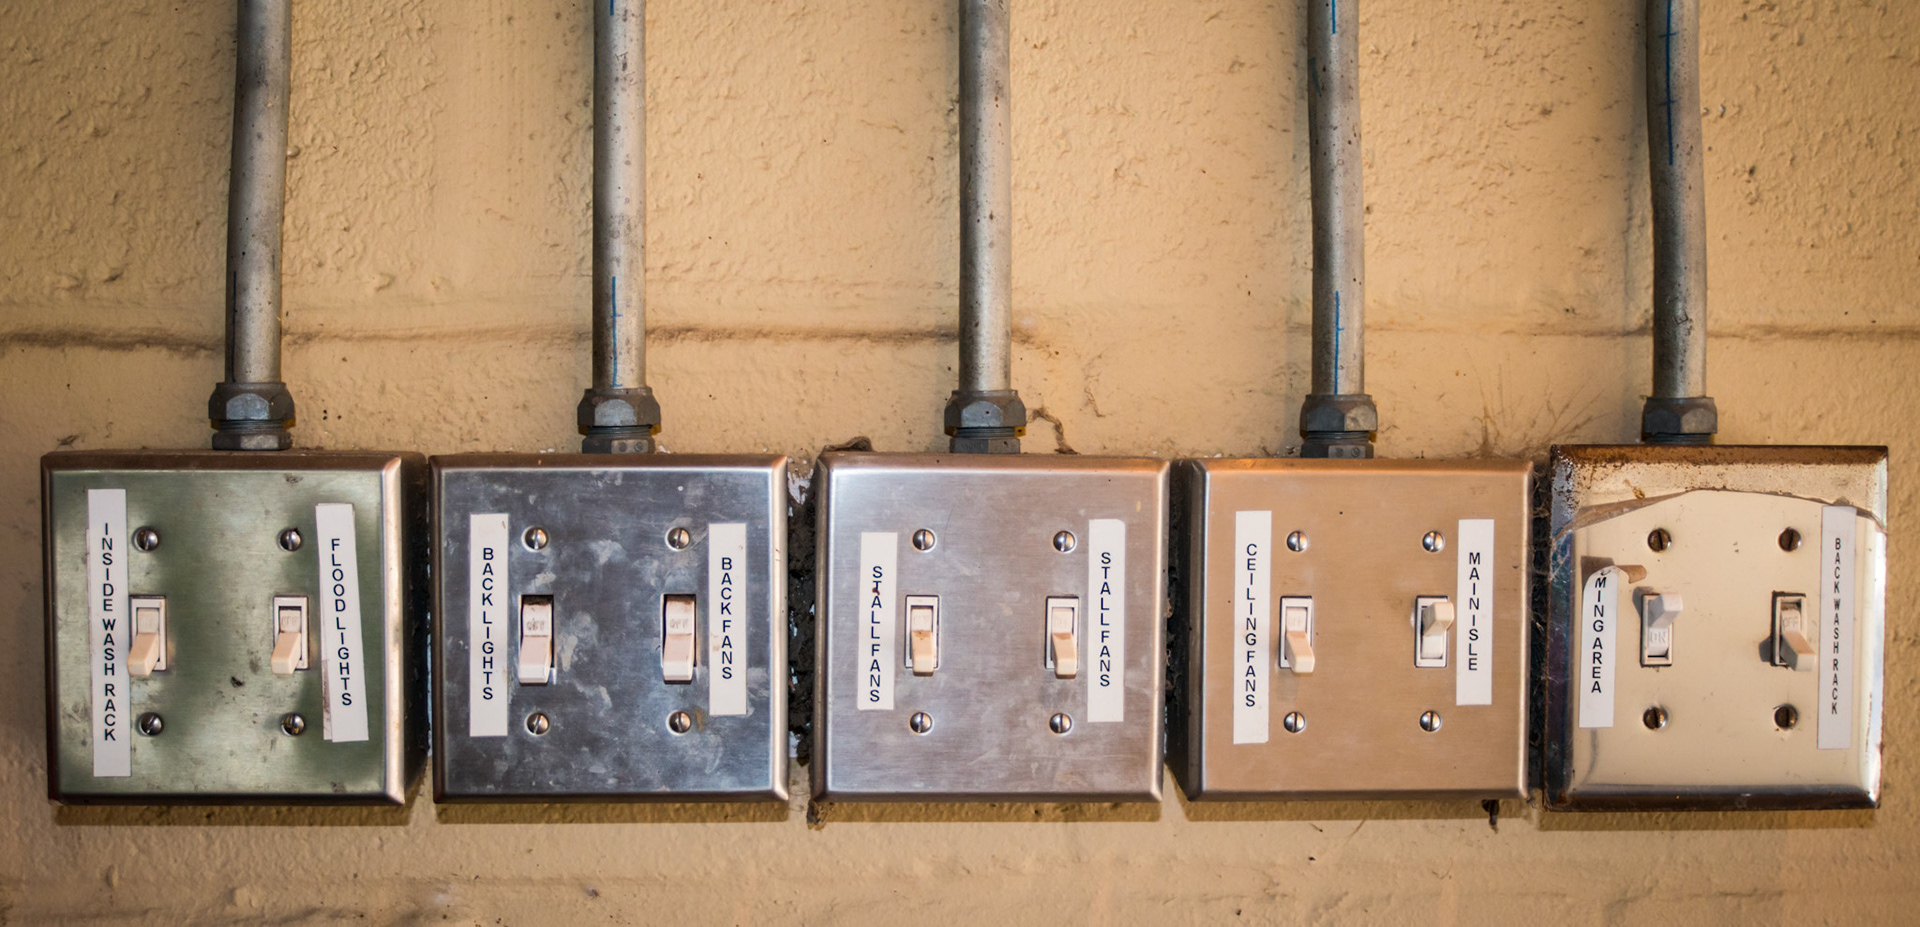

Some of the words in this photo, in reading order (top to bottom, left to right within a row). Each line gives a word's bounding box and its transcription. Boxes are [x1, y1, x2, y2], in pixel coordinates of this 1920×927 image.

[101, 522, 115, 612] INSIDE
[331, 538, 346, 613] FLOOD
[481, 547, 495, 607] BACK
[720, 556, 733, 616] BACK
[1099, 551, 1112, 626] STALL
[1244, 543, 1258, 647] CEILING
[1468, 551, 1481, 611] MAIN
[1833, 537, 1842, 594] BACK
[870, 565, 883, 640] STALL
[1833, 598, 1841, 654] WASH
[101, 618, 117, 677] WASH
[335, 616, 353, 706] LIGHTS
[481, 610, 495, 701] LIGHTS
[720, 619, 733, 680] FANS
[1099, 630, 1111, 687] FANS
[1468, 614, 1479, 671] ISLE
[1590, 636, 1603, 694] AREA
[869, 643, 882, 703] FANS
[1244, 650, 1257, 708] FANS
[1831, 658, 1839, 715] RACK
[104, 683, 117, 742] RACK
